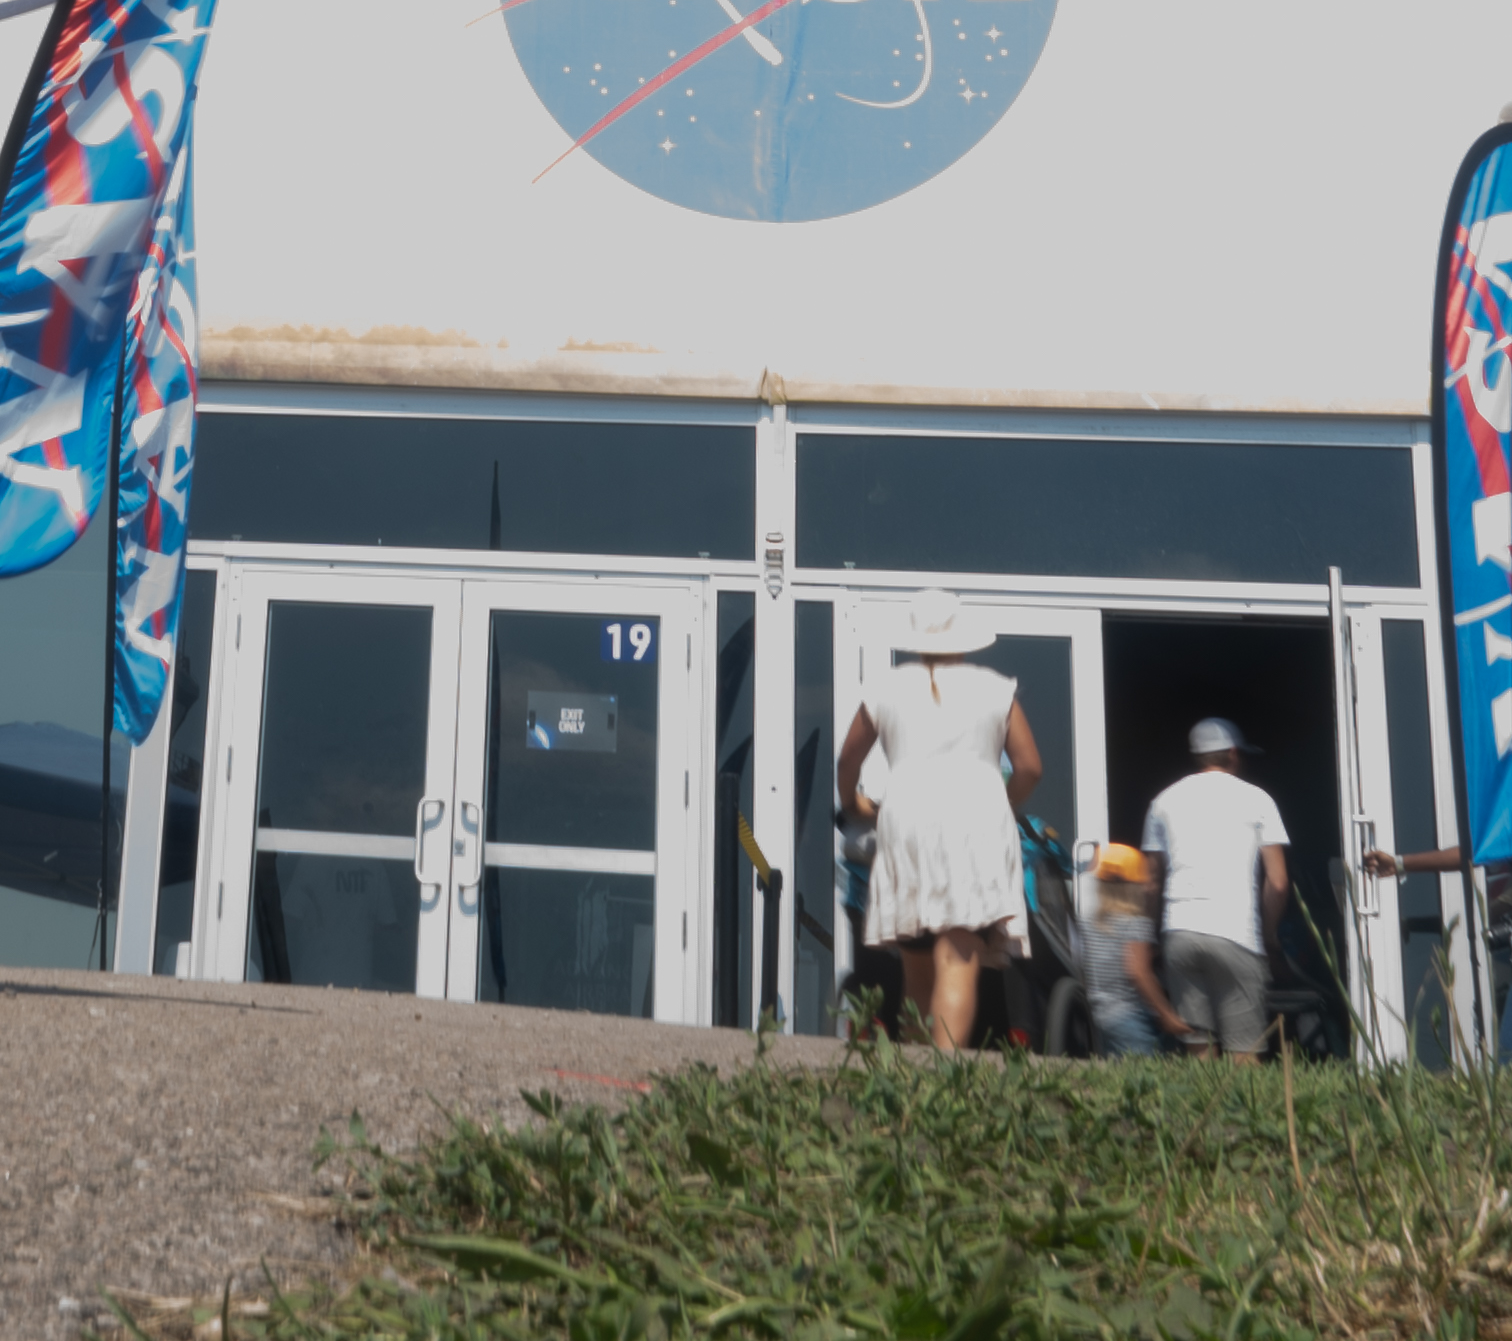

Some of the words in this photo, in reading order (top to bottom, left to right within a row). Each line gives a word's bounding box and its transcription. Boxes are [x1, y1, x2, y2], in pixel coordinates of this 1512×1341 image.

[606, 623, 652, 660] 19
[561, 708, 584, 720] EXIT
[558, 720, 585, 733] ONLY
